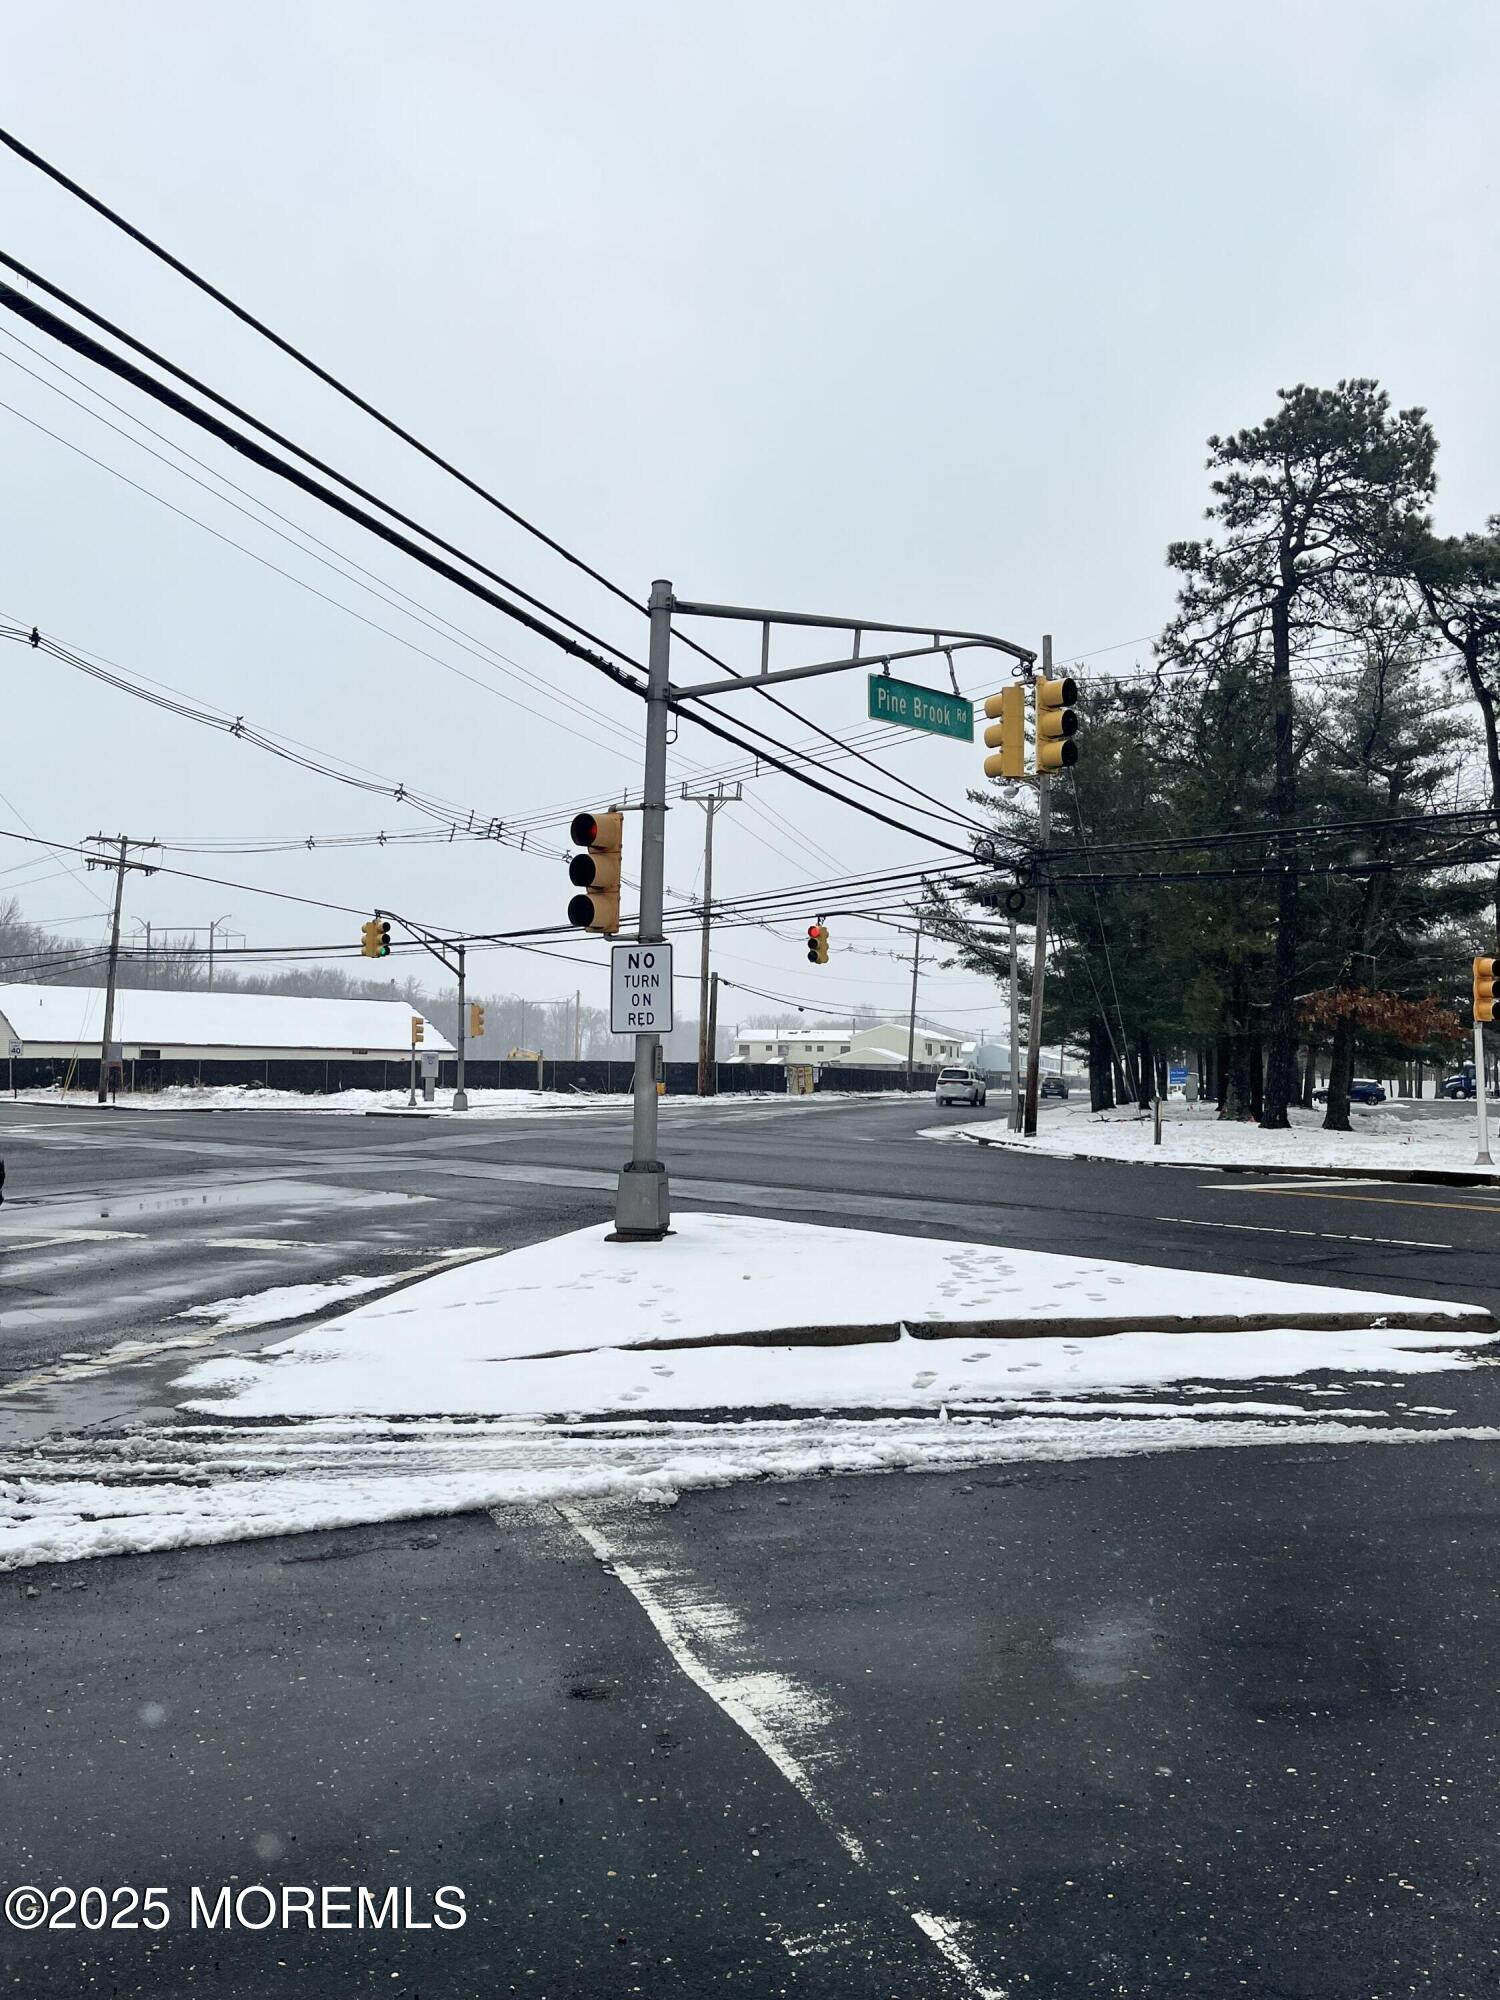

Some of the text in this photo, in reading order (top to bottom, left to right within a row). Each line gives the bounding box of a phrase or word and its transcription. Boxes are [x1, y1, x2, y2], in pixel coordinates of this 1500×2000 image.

[878, 687, 967, 726] Pine Brook Rd
[628, 952, 655, 969] NO
[624, 974, 660, 988] TURN
[631, 993, 652, 1007] ON
[628, 1012, 655, 1026] RED
